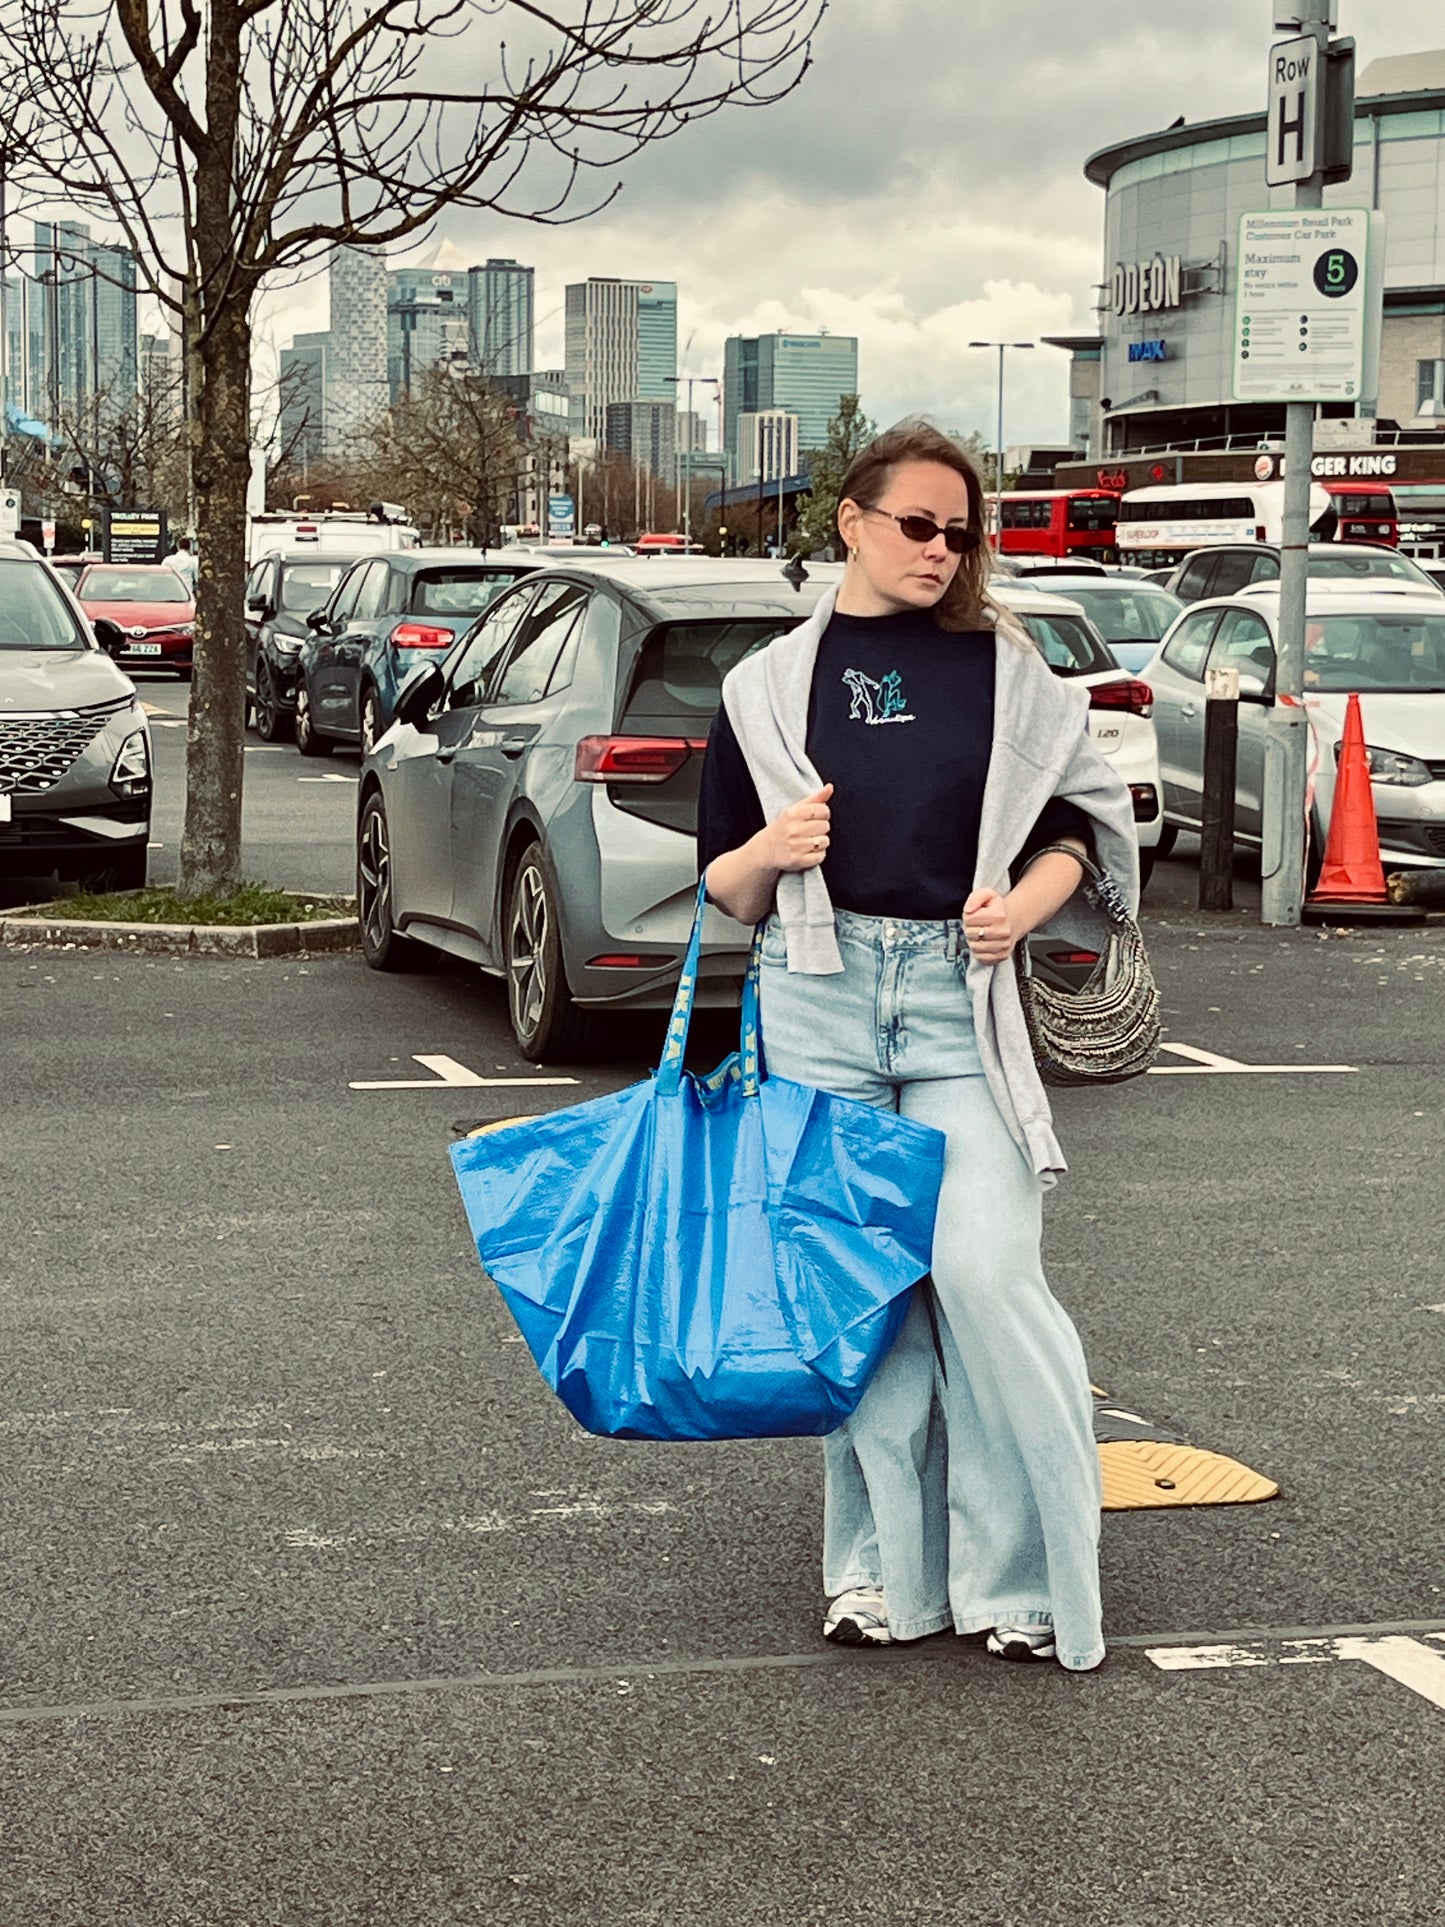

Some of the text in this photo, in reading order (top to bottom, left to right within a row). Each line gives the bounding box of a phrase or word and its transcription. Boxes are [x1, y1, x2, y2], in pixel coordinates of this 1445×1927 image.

[1275, 56, 1311, 84] Row
[1277, 91, 1305, 167] H
[1330, 216, 1353, 226] Park
[1294, 230, 1313, 240] Car
[1314, 228, 1337, 239] Park
[1244, 253, 1301, 264] Maximum
[1244, 269, 1267, 279] stay
[1326, 254, 1345, 284] 5
[432, 274, 452, 287] citi
[1111, 255, 1181, 316] ODEON
[1350, 455, 1397, 475] KING
[666, 973, 693, 1062] IKEA
